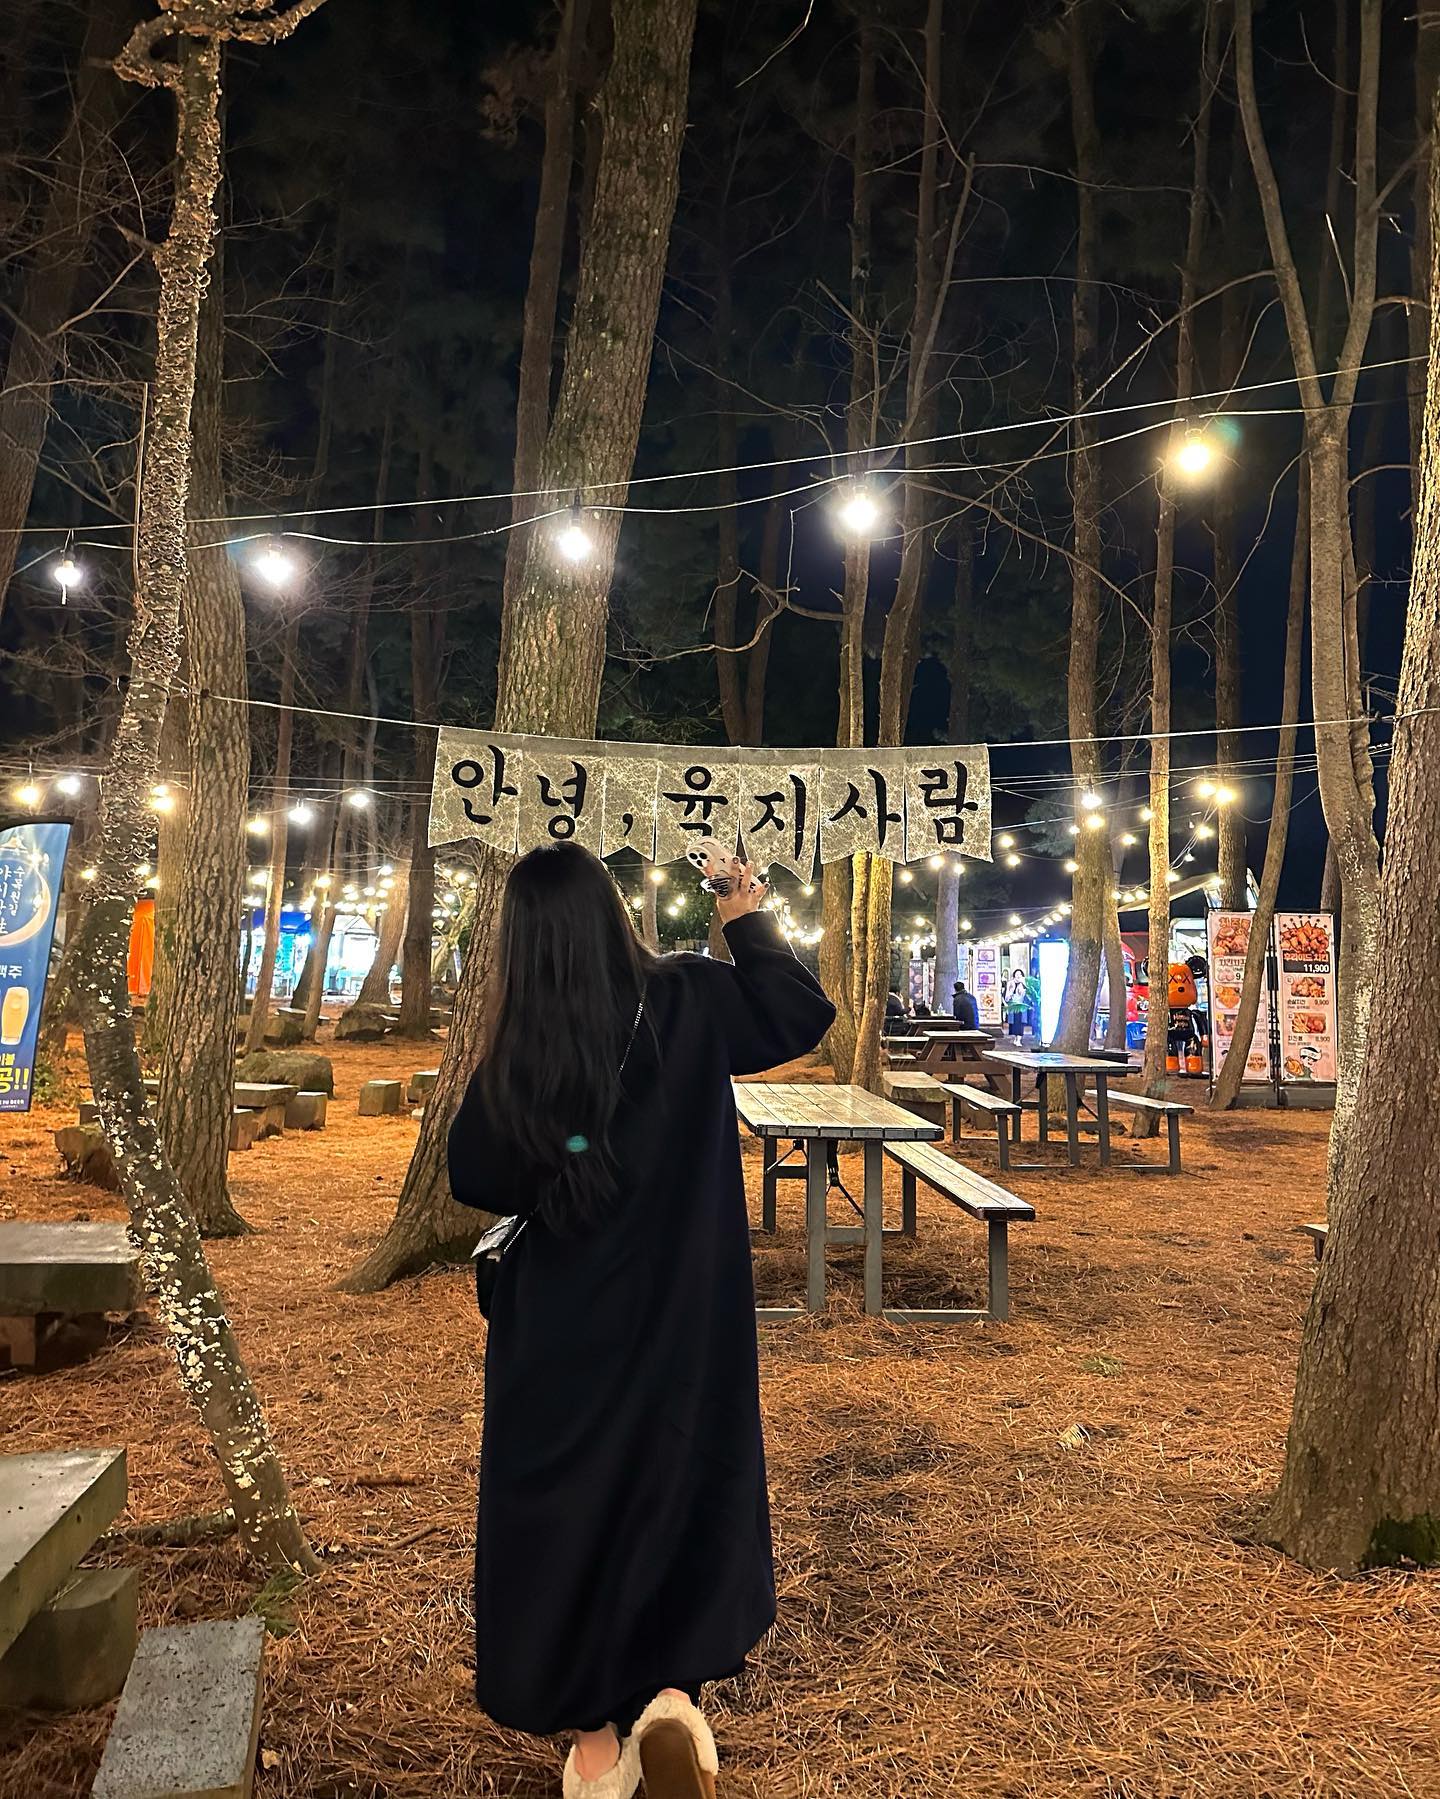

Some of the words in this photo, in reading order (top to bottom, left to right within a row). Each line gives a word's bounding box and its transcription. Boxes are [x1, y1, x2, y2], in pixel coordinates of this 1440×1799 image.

[451, 744, 635, 840] 안녕,
[662, 760, 978, 862] 육지사람
[1303, 963, 1330, 974] 11,900
